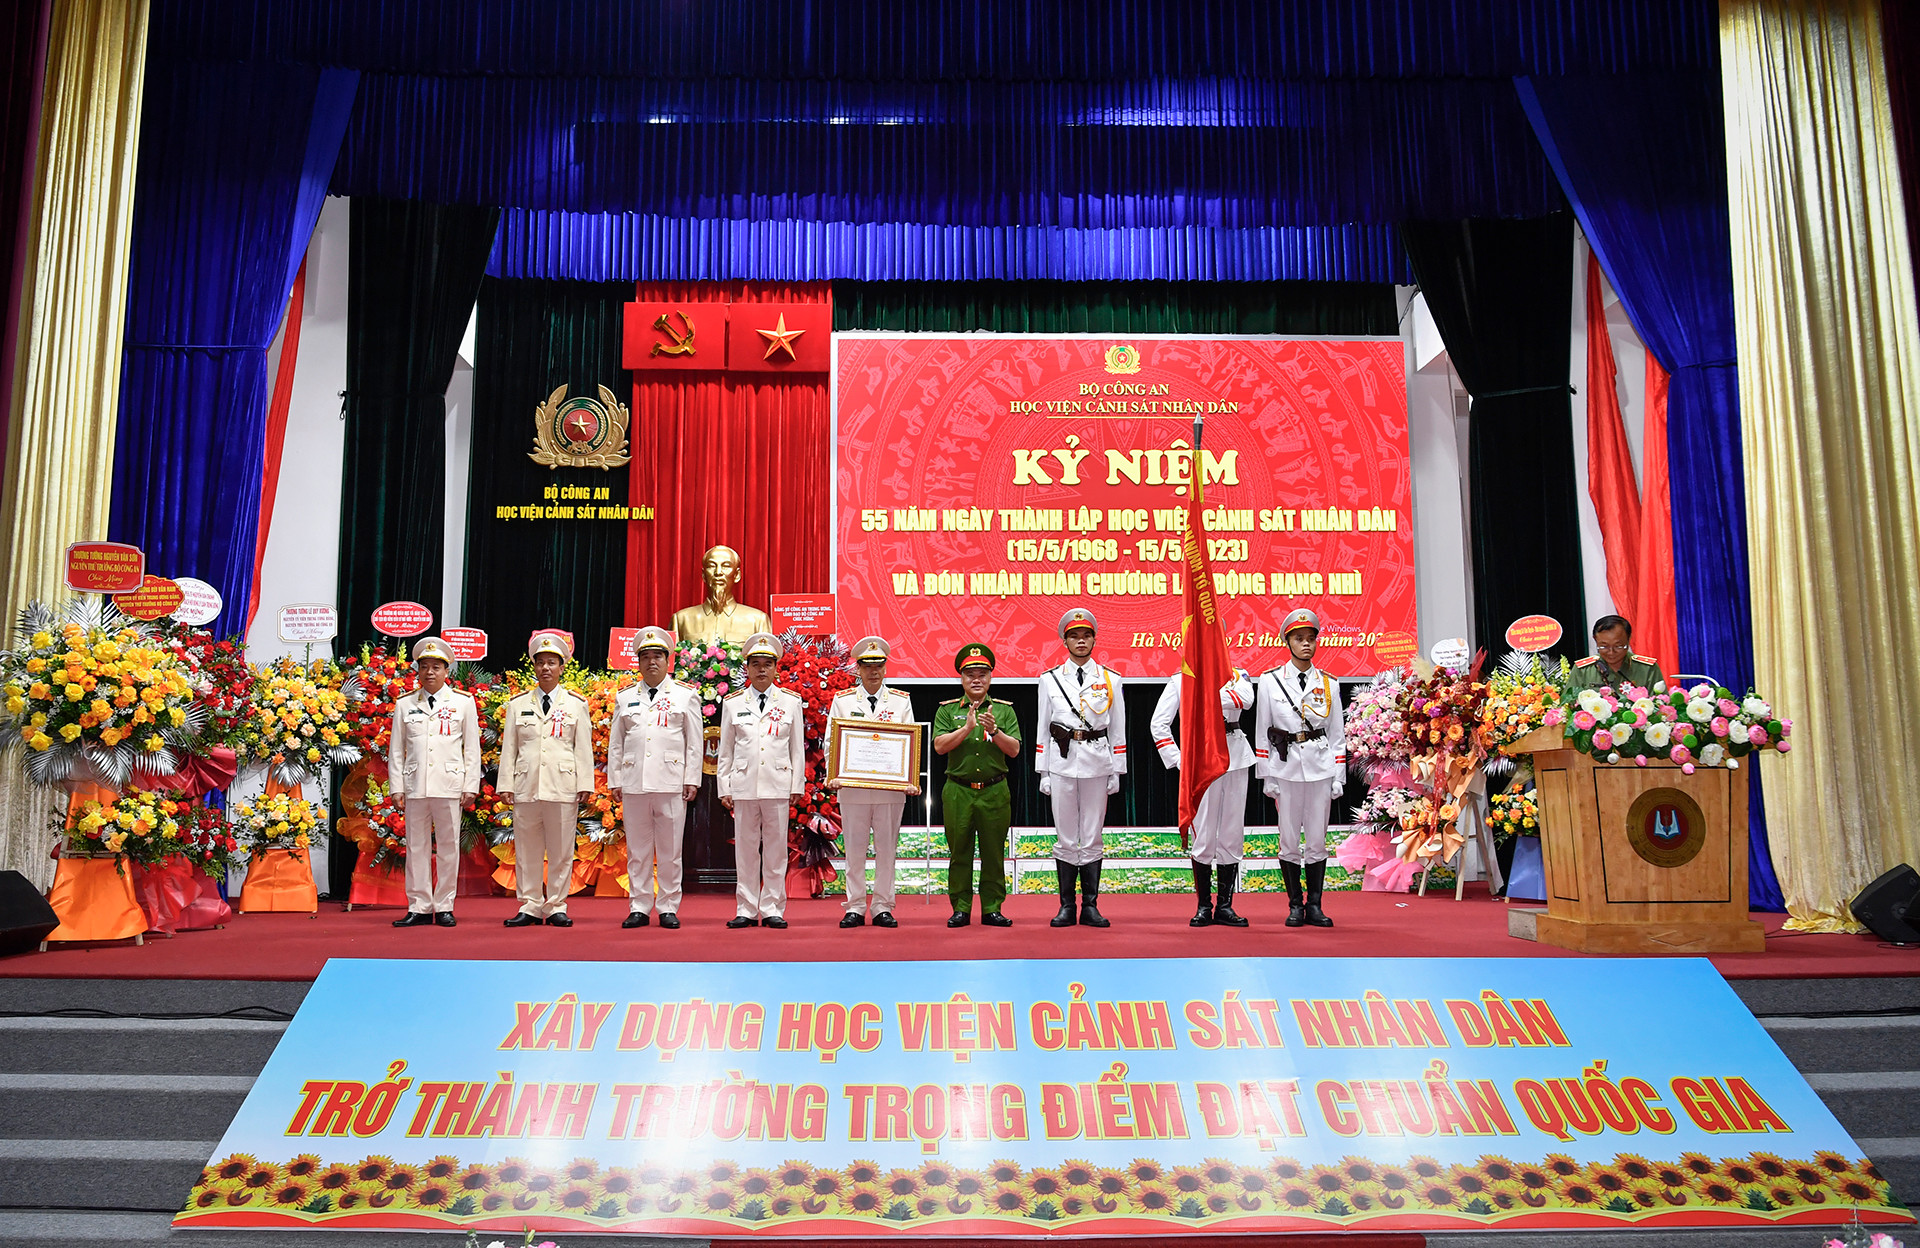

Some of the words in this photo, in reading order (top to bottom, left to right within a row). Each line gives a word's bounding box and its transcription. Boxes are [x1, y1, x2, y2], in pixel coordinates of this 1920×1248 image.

[1079, 382, 1100, 398] BỘ
[1103, 380, 1147, 396] CÔNG
[1149, 383, 1169, 396] AN
[1010, 400, 1043, 416] HỌC
[1047, 400, 1082, 416] VIỆN
[1085, 398, 1127, 414] CẢNH
[1130, 398, 1159, 413] SÁT
[1162, 399, 1204, 414] NHÂN
[1207, 399, 1239, 414] DÂN
[1011, 434, 1091, 486] KỶ
[1104, 438, 1240, 496] NIỆM
[543, 483, 559, 502] BỘ
[560, 484, 591, 500] CÔNG
[593, 487, 610, 500] AN
[496, 505, 518, 521] HỌC
[520, 503, 544, 521] VIỆN
[545, 501, 575, 519] CẢNH
[576, 503, 597, 519] SÁT
[598, 504, 629, 520] NHÂN
[632, 504, 654, 520] DÂN
[860, 508, 889, 532] 55
[893, 505, 937, 532] NĂM
[942, 505, 994, 532] NGÀY
[998, 505, 1063, 532] THÀNH
[1068, 504, 1104, 536] LẬP
[1108, 508, 1149, 536] HỌC
[1202, 504, 1255, 532] CẢNH
[1259, 506, 1296, 532] SÁT
[1301, 505, 1352, 532] NHÂN
[1357, 506, 1397, 532] DÂN
[1007, 538, 1119, 562] (15/5/1968
[891, 569, 920, 596] VÀ
[924, 569, 965, 596] ĐÓN
[970, 568, 1023, 600] NHẬN
[1028, 568, 1082, 596] HUÂN
[1086, 570, 1168, 596] CHƯƠNG
[1270, 573, 1324, 600] HẠNG
[1328, 569, 1363, 596] NHÌ
[1198, 590, 1216, 625] QUỐC
[1327, 625, 1361, 633] Windows
[1130, 632, 1155, 648] Hà
[1158, 632, 1184, 651] Nộ
[1236, 633, 1255, 648] 15
[1319, 632, 1353, 648] năm
[496, 992, 617, 1051] XÂY
[616, 997, 766, 1063] DỰNG
[775, 1001, 884, 1064] HỌC
[895, 992, 1017, 1064] VIỆN
[1029, 981, 1178, 1051] CẢNH
[1183, 989, 1285, 1050] SÁT
[1290, 989, 1451, 1049] NHÂN
[1443, 989, 1573, 1048] DÂN
[283, 1058, 415, 1139] TRỞ
[405, 1070, 600, 1140] THÀNH
[606, 1069, 829, 1143] TRƯỜNG
[842, 1082, 1030, 1156] TRỌNG
[1040, 1061, 1190, 1141] ĐIỂM
[1193, 1078, 1308, 1152] ĐẠT
[1314, 1058, 1520, 1138] CHUẨN
[1513, 1058, 1678, 1144] QUỐC
[1669, 1076, 1794, 1134] GIA
